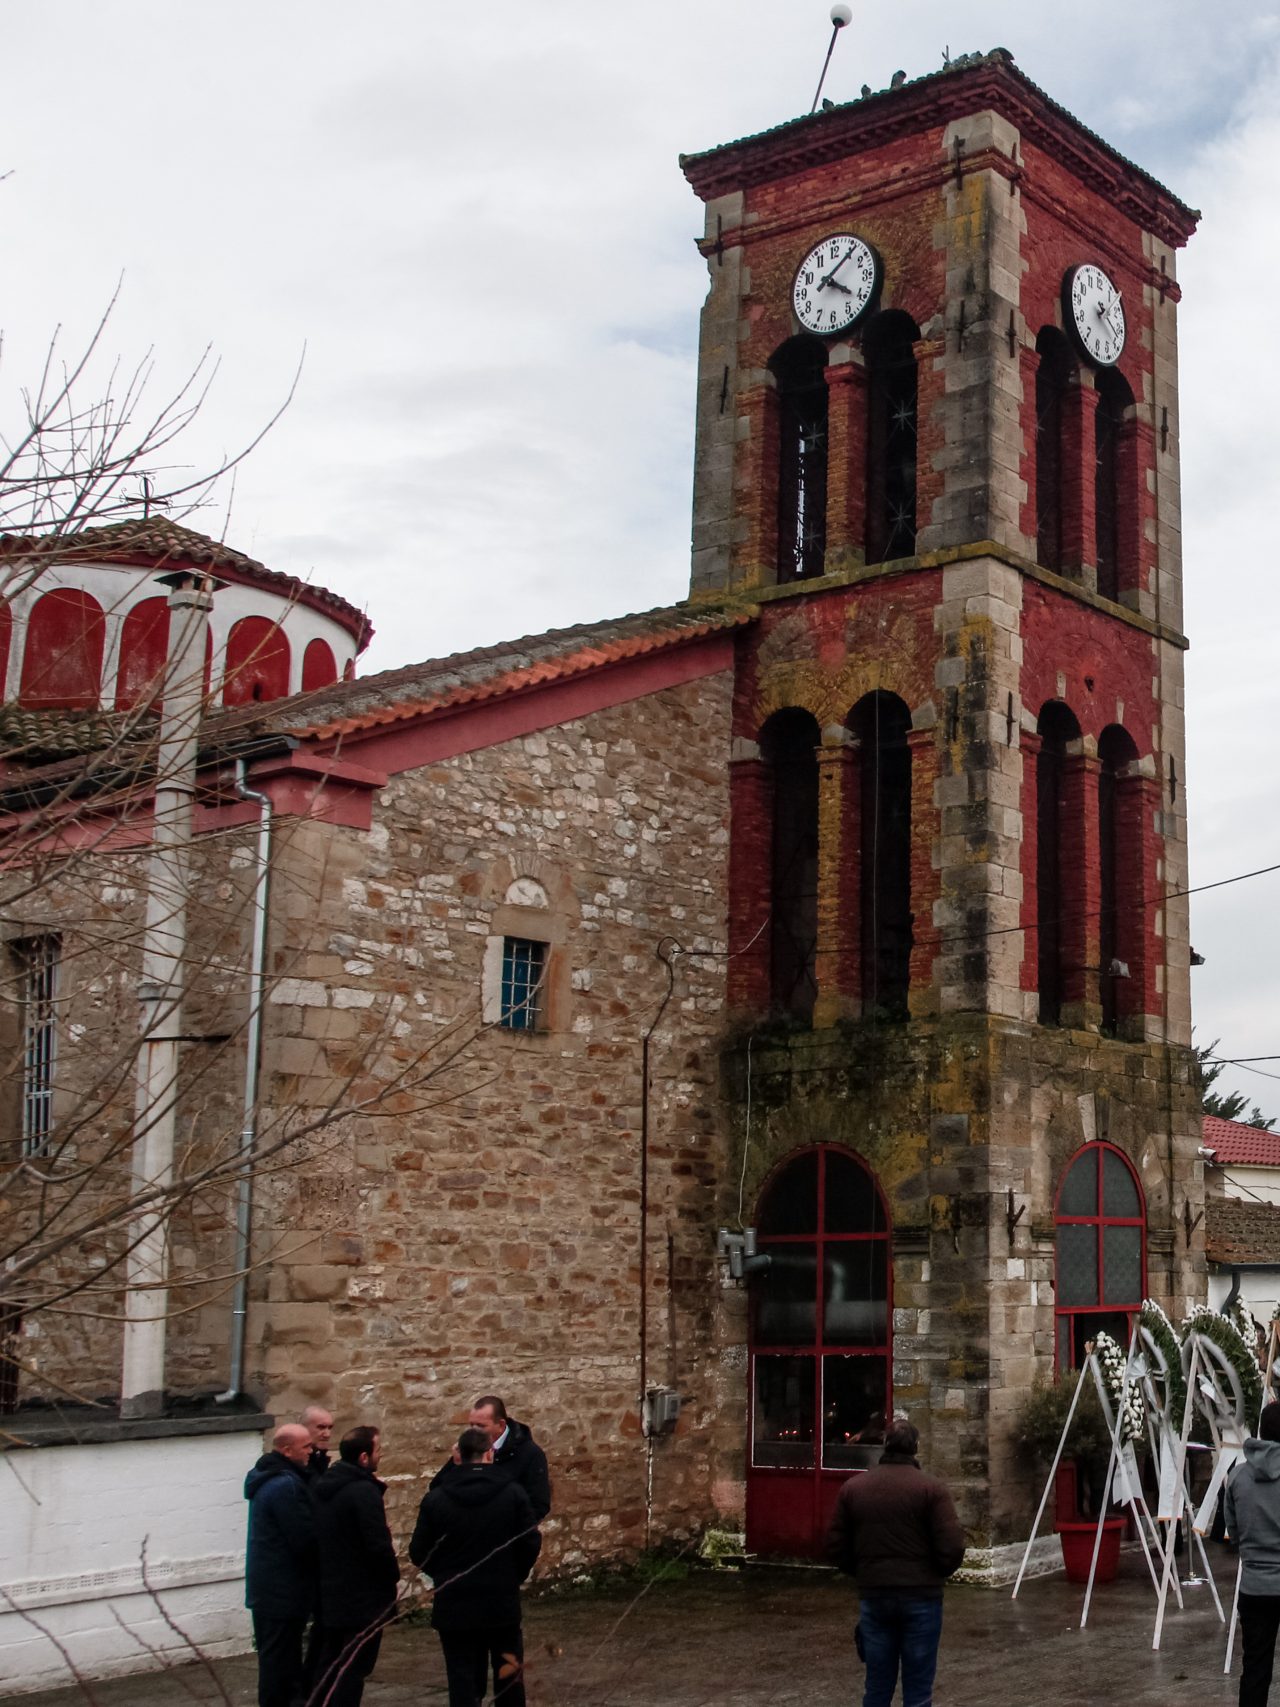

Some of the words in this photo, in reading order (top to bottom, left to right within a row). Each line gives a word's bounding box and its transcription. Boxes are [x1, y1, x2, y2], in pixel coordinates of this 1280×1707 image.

[830, 245, 840, 260] 12
[817, 254, 824, 269] 11
[857, 255, 864, 269] 2
[805, 271, 814, 286] 10
[862, 268, 869, 282] 3
[801, 287, 807, 301] 9
[856, 287, 864, 301] 4
[1080, 282, 1087, 297] 10
[805, 300, 812, 314] 8
[845, 301, 851, 315] 5
[816, 308, 823, 322] 7
[830, 310, 837, 323] 6
